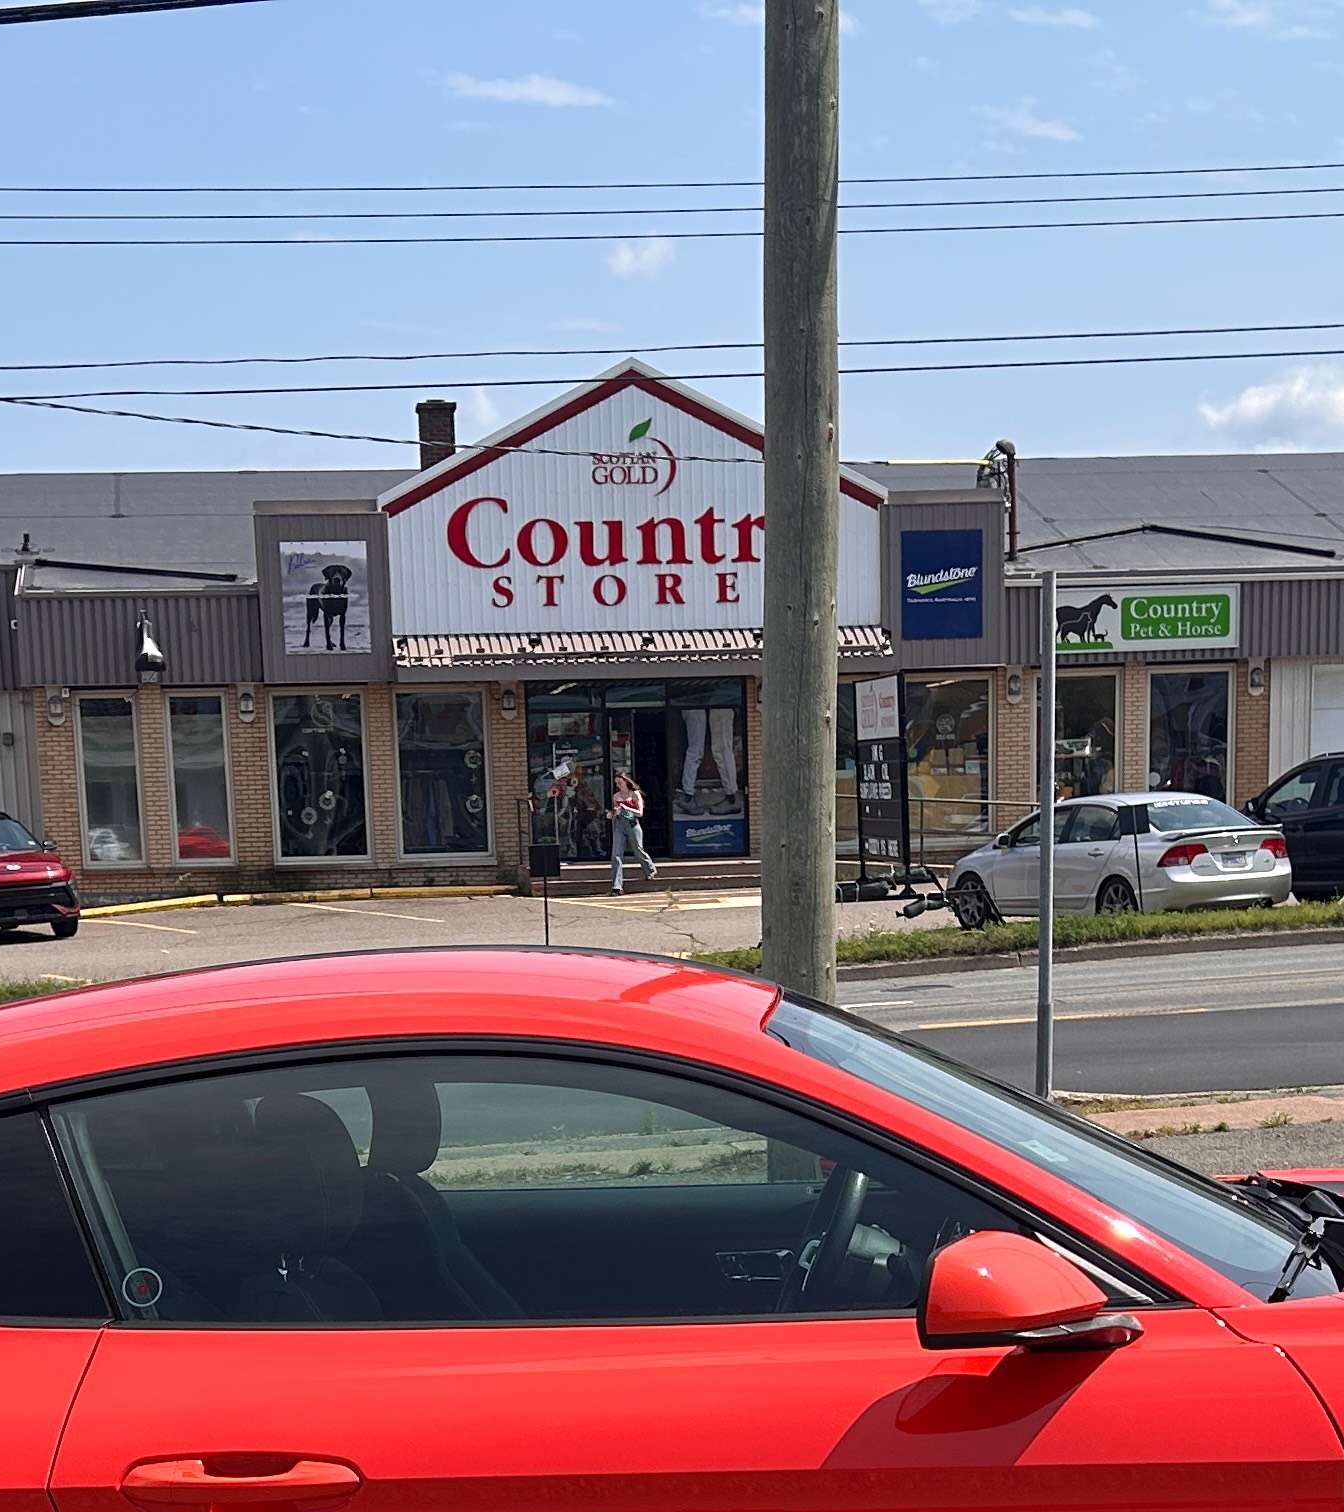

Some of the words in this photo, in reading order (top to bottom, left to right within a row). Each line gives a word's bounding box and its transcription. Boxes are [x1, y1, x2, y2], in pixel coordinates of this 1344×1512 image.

[592, 466, 658, 485] GOLD
[447, 497, 765, 569] Countr
[906, 566, 978, 588] Blundstone
[492, 572, 740, 608] STORE
[1130, 598, 1223, 623] Country
[1130, 622, 1153, 638] Pet
[1158, 623, 1172, 637] &
[1177, 621, 1222, 637] Horse
